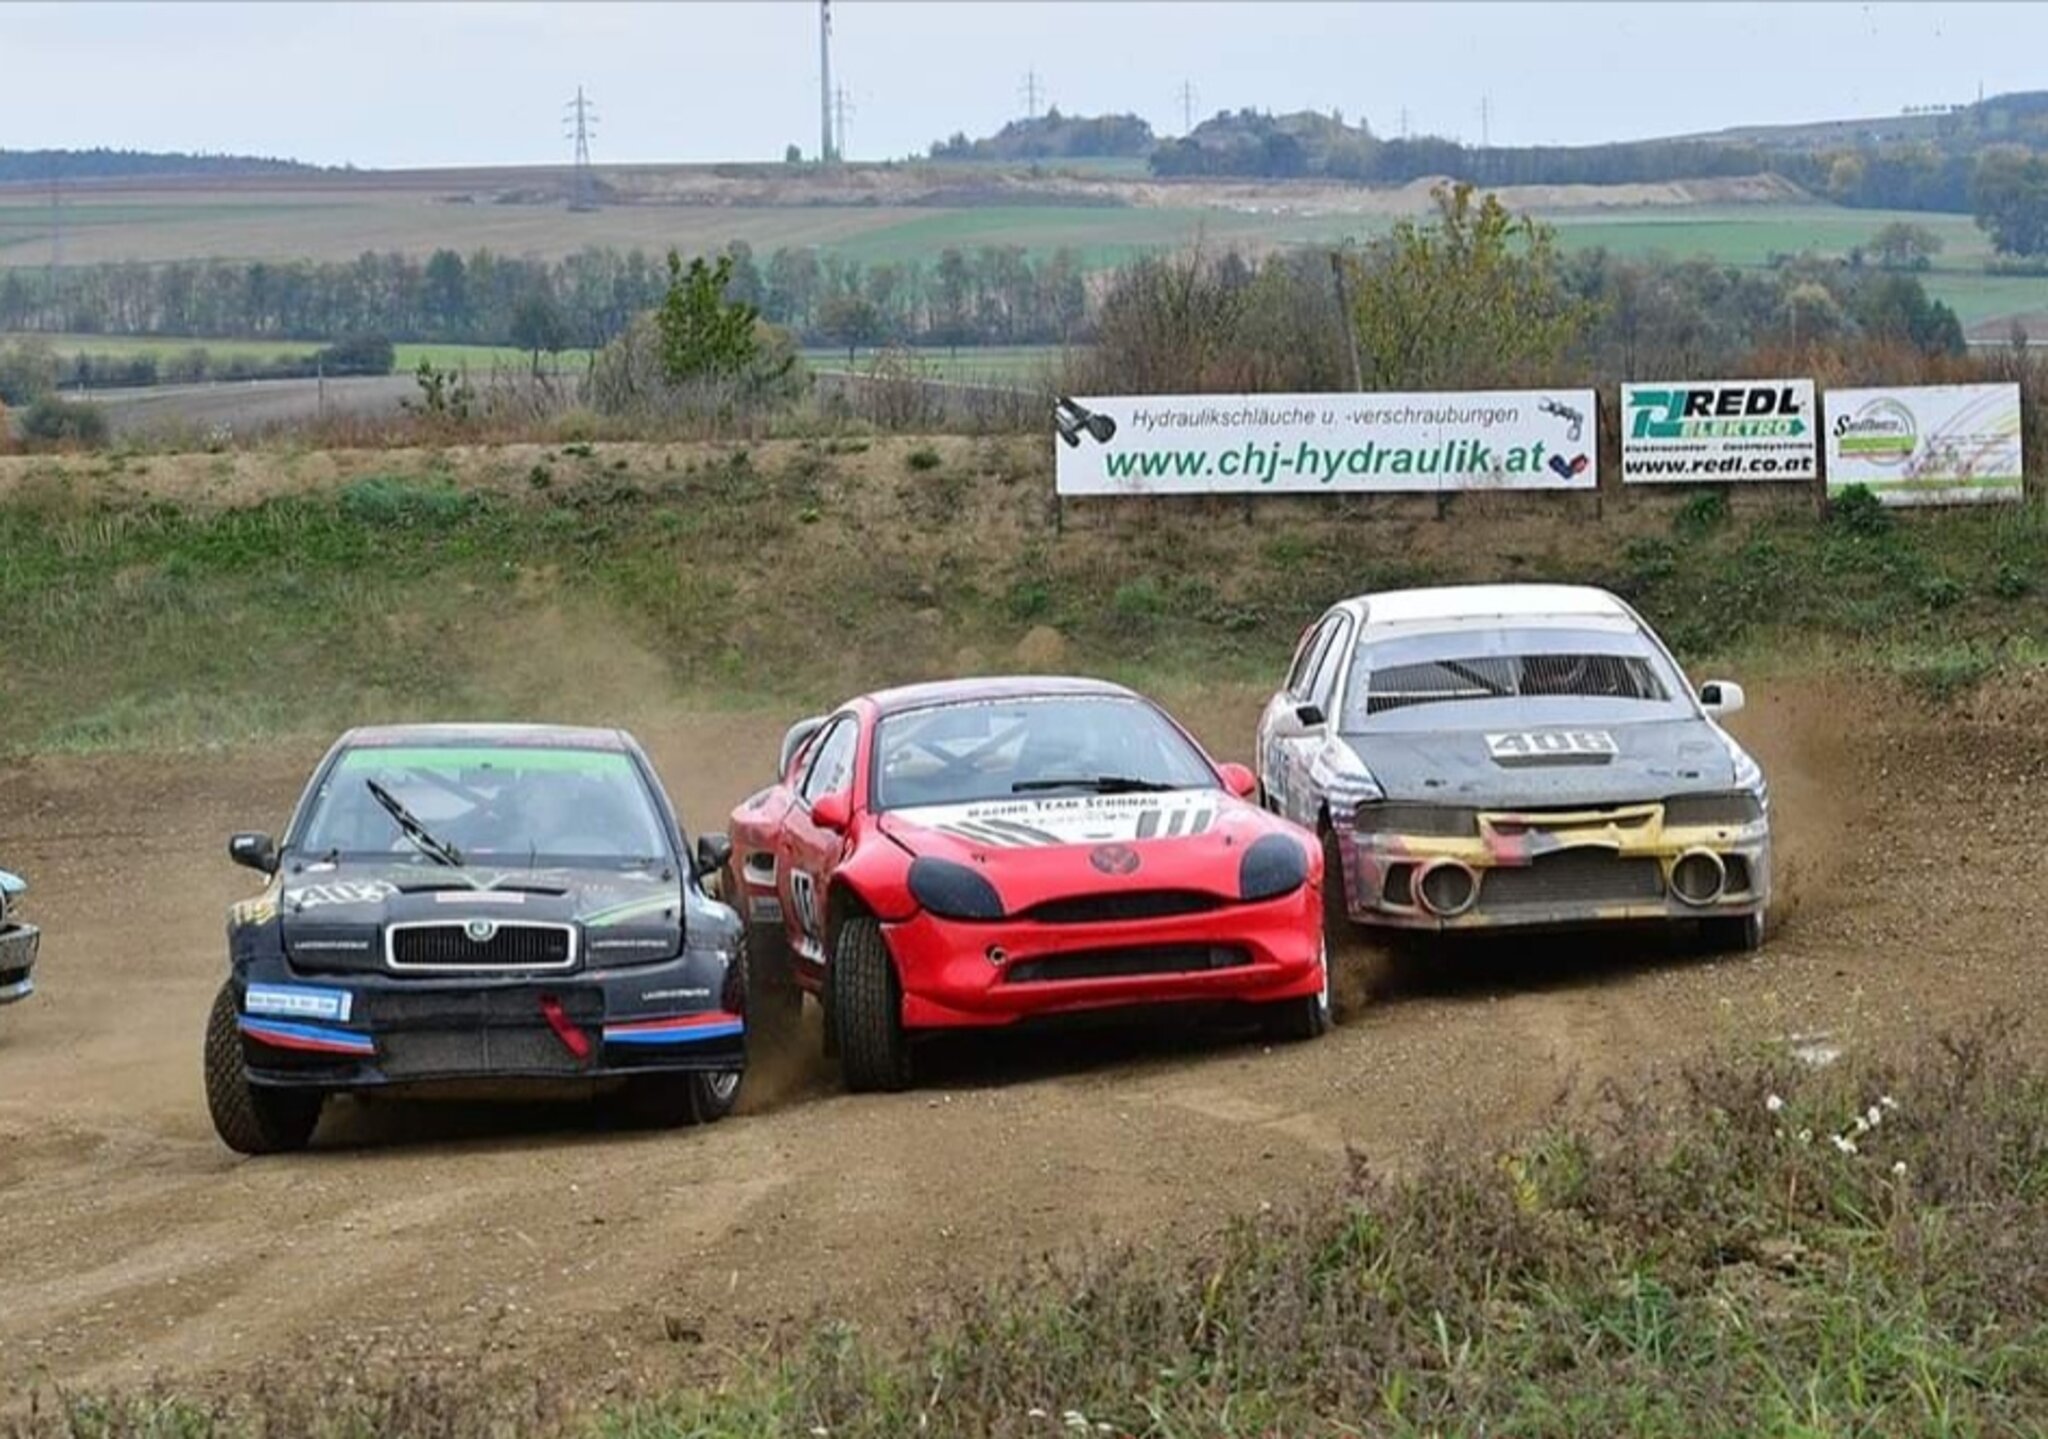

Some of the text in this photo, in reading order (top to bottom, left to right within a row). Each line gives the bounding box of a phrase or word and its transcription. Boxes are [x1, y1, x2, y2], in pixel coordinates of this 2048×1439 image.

[1684, 387, 1799, 416] REDL
[1132, 408, 1315, 431] Hydraulikschläuche
[1346, 405, 1518, 427] -verschraubungen
[1680, 420, 1792, 438] ELEKTRO
[1106, 439, 1545, 484] www.chj-hydraulik.at
[1625, 456, 1813, 474] www.redl.co.at
